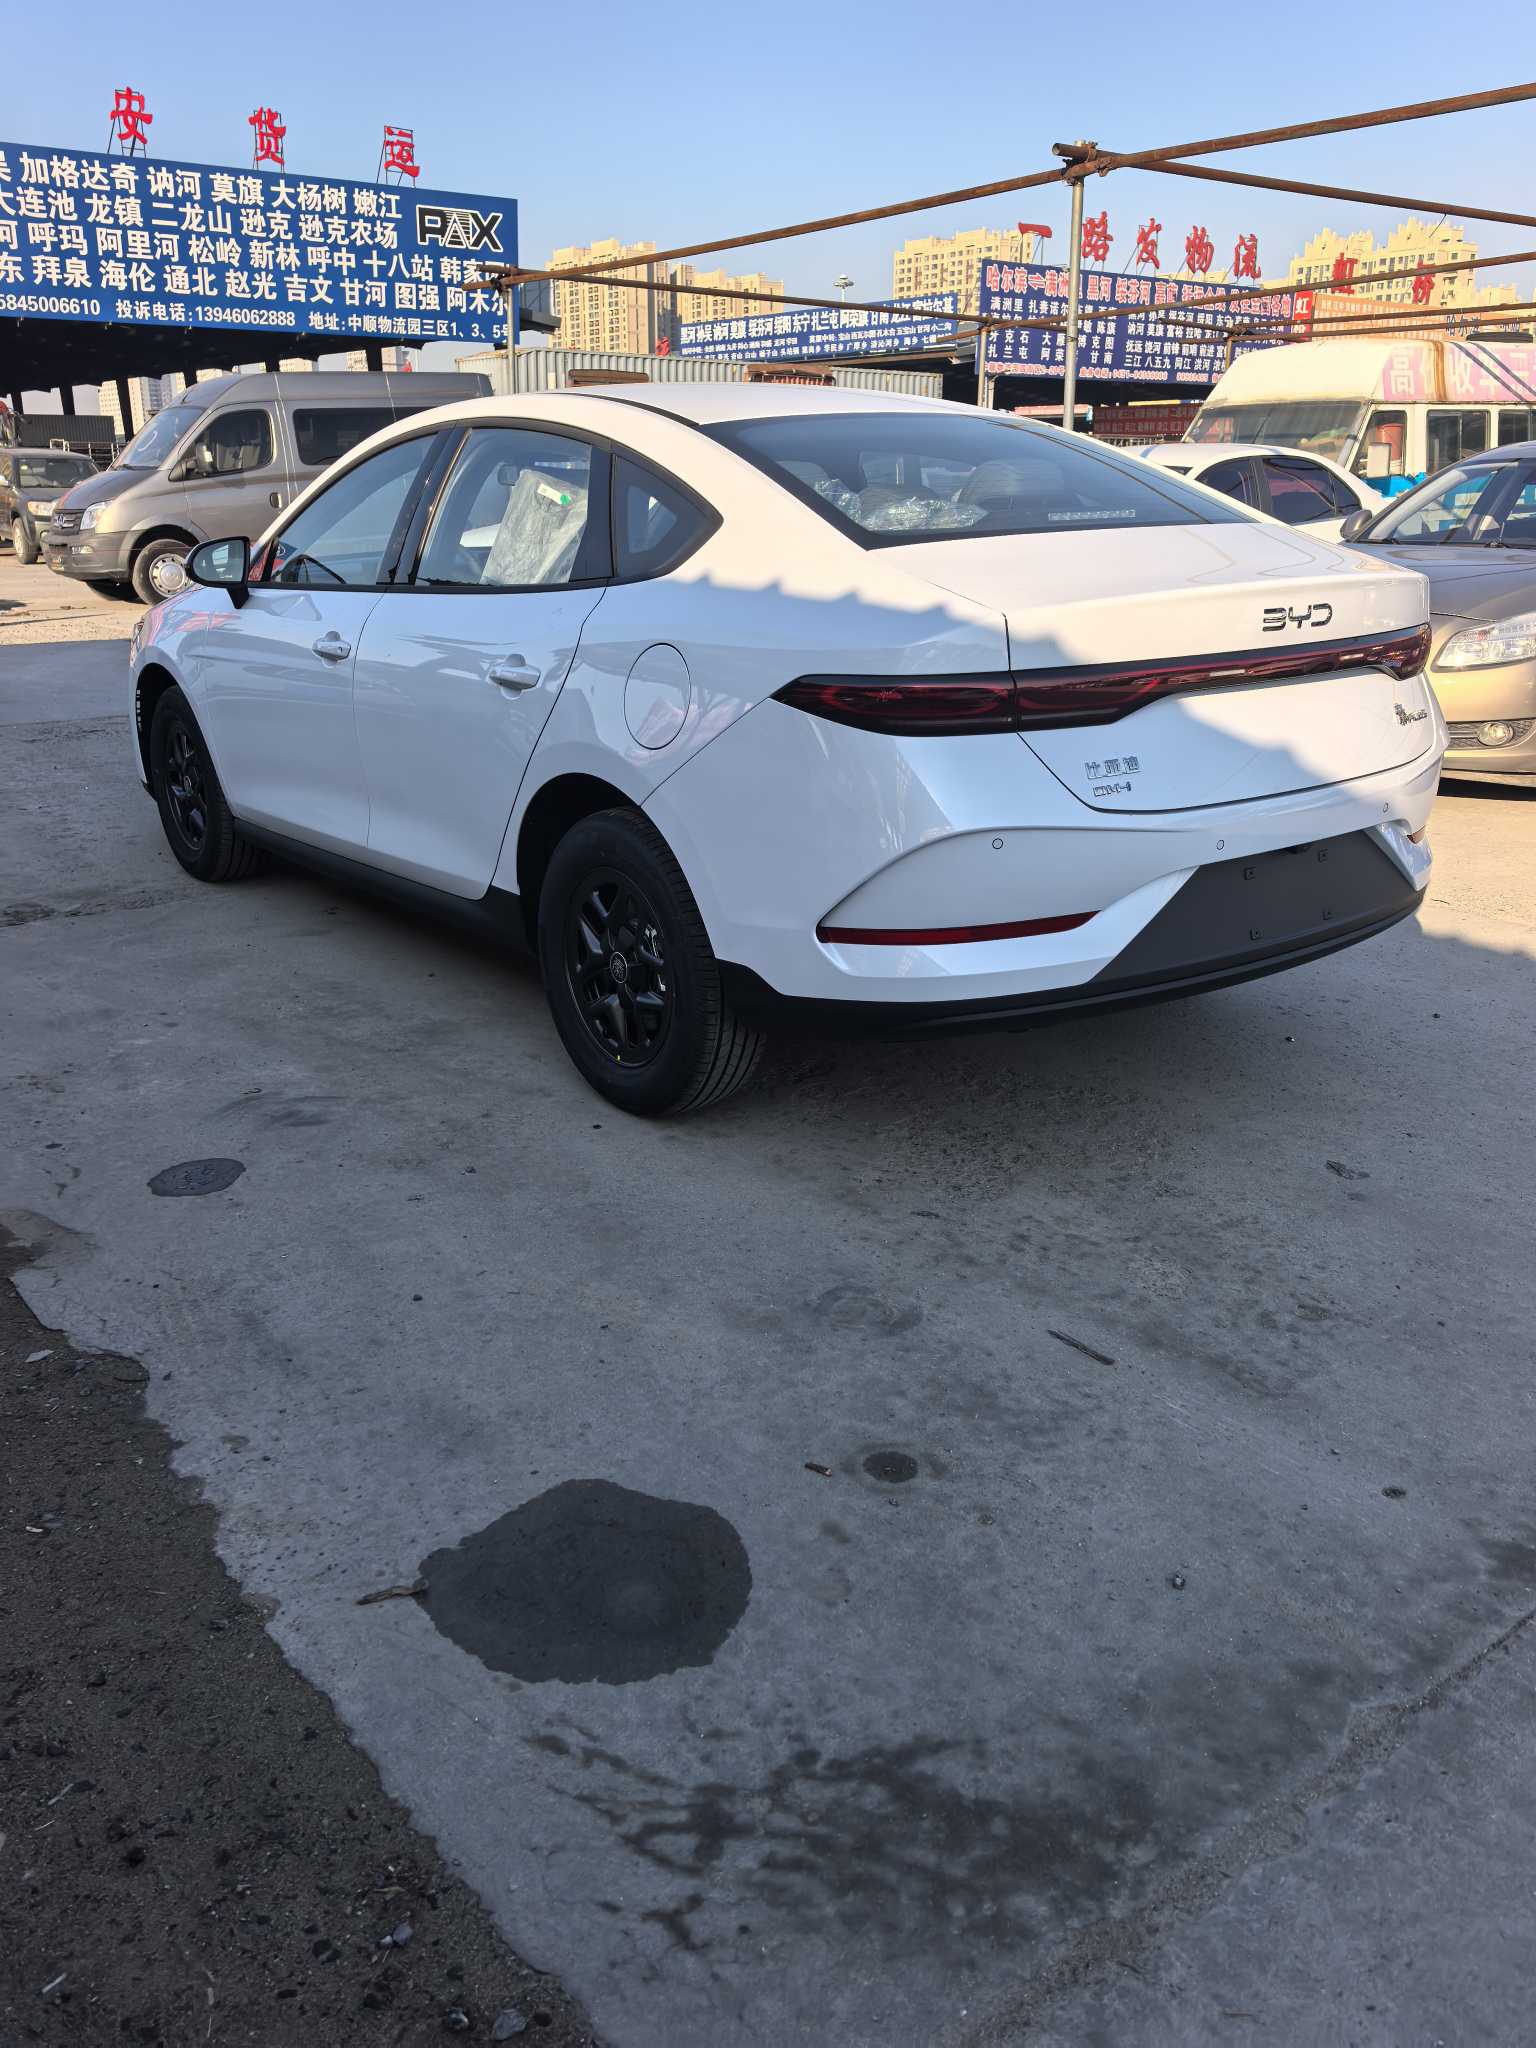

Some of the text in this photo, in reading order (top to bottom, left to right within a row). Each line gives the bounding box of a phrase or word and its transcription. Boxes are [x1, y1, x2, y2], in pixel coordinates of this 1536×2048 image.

[19, 151, 139, 194] 加格达奇
[147, 166, 201, 200] 讷河
[209, 172, 265, 207] 莫旗
[270, 179, 347, 215] 大杨树
[352, 187, 402, 219] 嫩江
[85, 192, 143, 227] 龙镇
[152, 202, 232, 235] 二龙山
[240, 208, 293, 240] 逊克
[299, 213, 398, 249] 逊克农场
[28, 223, 88, 256] 呼玛
[95, 227, 179, 262] 阿里河
[188, 234, 242, 268] 松岭
[250, 239, 301, 271] 新林
[307, 247, 356, 276] 呼中
[363, 250, 433, 282] 十八站
[986, 264, 1028, 294] 哈尔滨
[31, 255, 92, 288] 拜泉
[99, 259, 156, 292] 海伦
[163, 264, 218, 296] 通北
[225, 268, 277, 300] 赵光
[283, 273, 335, 304] 吉文
[340, 278, 387, 308] 甘河
[395, 282, 441, 311] 图强
[991, 296, 1024, 312] 满洲里
[1262, 603, 1333, 632] BYD
